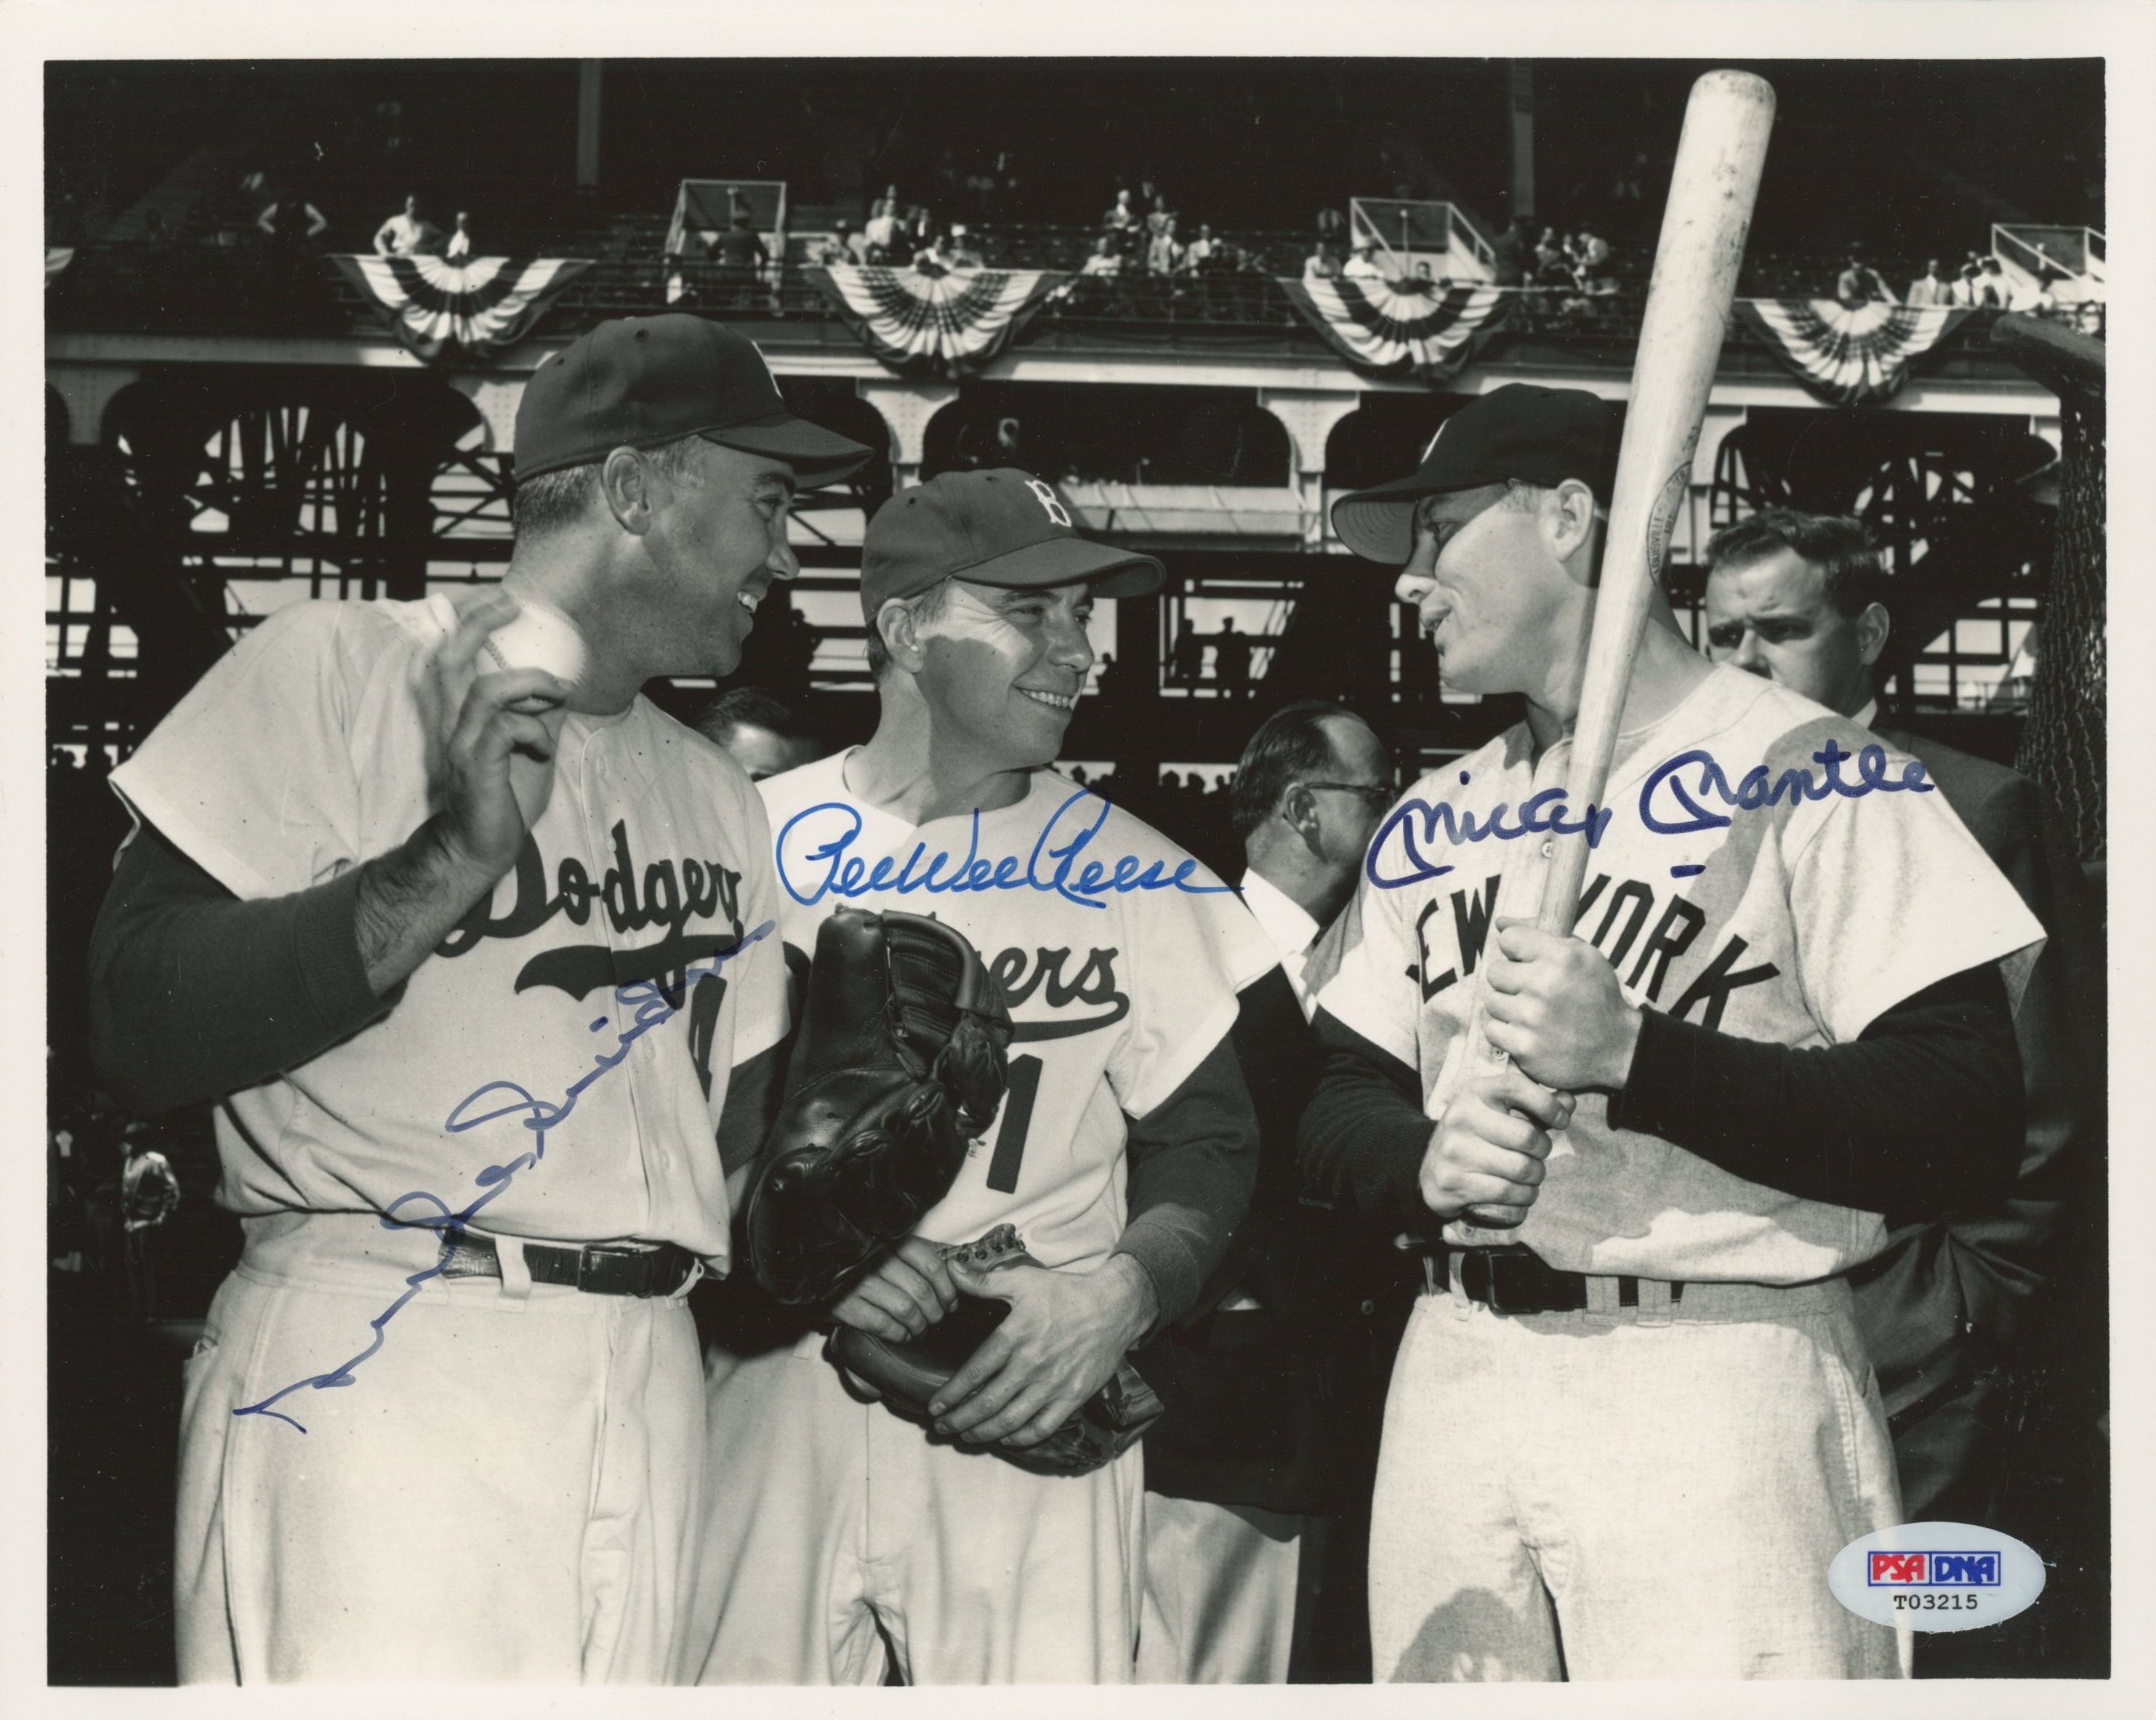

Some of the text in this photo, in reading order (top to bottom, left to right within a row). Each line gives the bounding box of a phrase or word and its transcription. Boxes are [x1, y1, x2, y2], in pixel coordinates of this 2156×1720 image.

[1024, 480, 1072, 528] B
[1639, 738, 1935, 835] Mantle
[1026, 787, 1245, 909] Reese
[977, 947, 1129, 1009] ers
[1405, 874, 1503, 1004] EW
[986, 1053, 1043, 1194] 1
